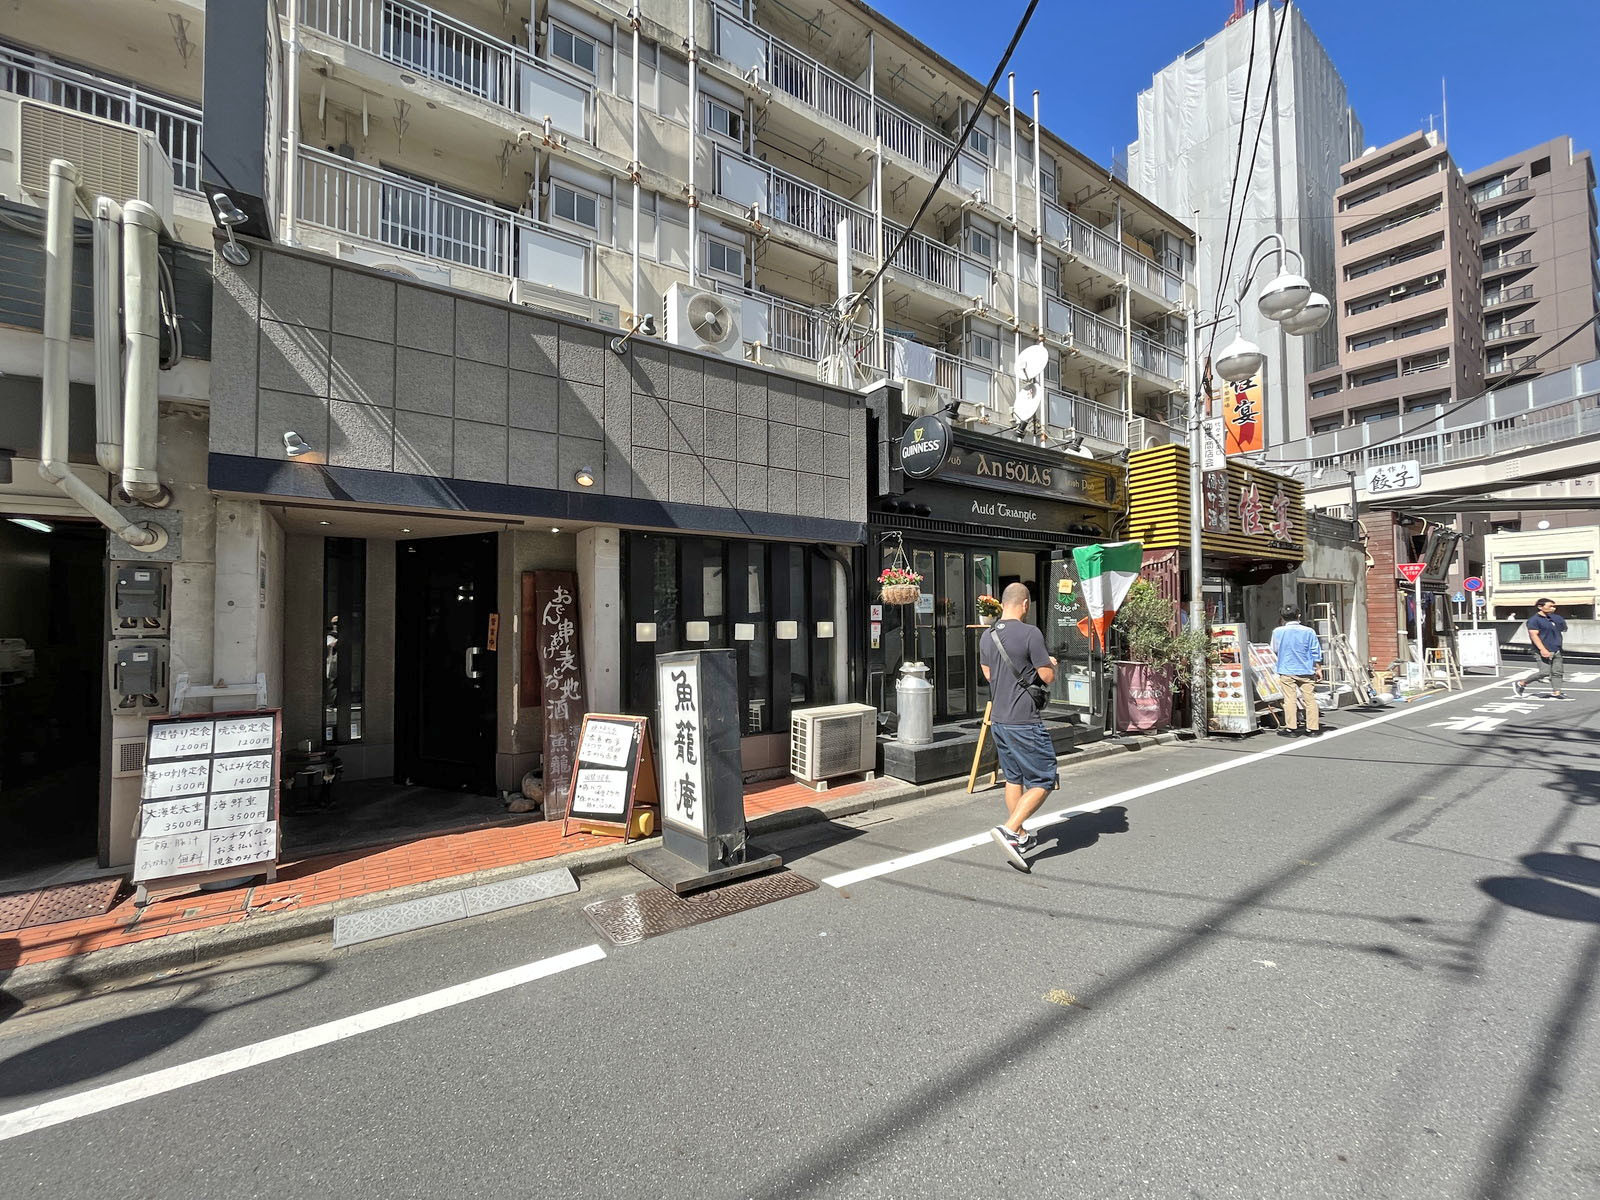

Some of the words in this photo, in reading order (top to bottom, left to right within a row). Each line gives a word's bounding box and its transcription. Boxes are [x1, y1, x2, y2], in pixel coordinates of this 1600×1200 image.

[902, 440, 940, 458] GUINNESS
[947, 456, 962, 466] ub
[1376, 464, 1407, 474] 手作り
[1369, 471, 1414, 491] 餃子
[972, 500, 995, 516] Auld
[542, 586, 572, 626] おでん
[543, 618, 575, 659] 串あげ
[544, 644, 578, 691] 麦とろ
[547, 677, 581, 720] 地酒
[218, 722, 271, 736] 焼き魚定食
[175, 743, 209, 752] 1200円
[238, 737, 269, 746] 1200円
[670, 669, 698, 820] 魚籠庵
[216, 759, 271, 774] さばみそ定食
[170, 783, 205, 792] 1300円
[233, 776, 268, 786] 1400円
[213, 796, 257, 811] 海鮮重
[228, 811, 266, 822] 3500円
[163, 819, 202, 831] 3500円
[212, 827, 272, 843] ランチタイムの
[216, 840, 269, 855] お支払いは
[178, 851, 204, 865] 無料
[213, 850, 272, 866] 現金のみです
